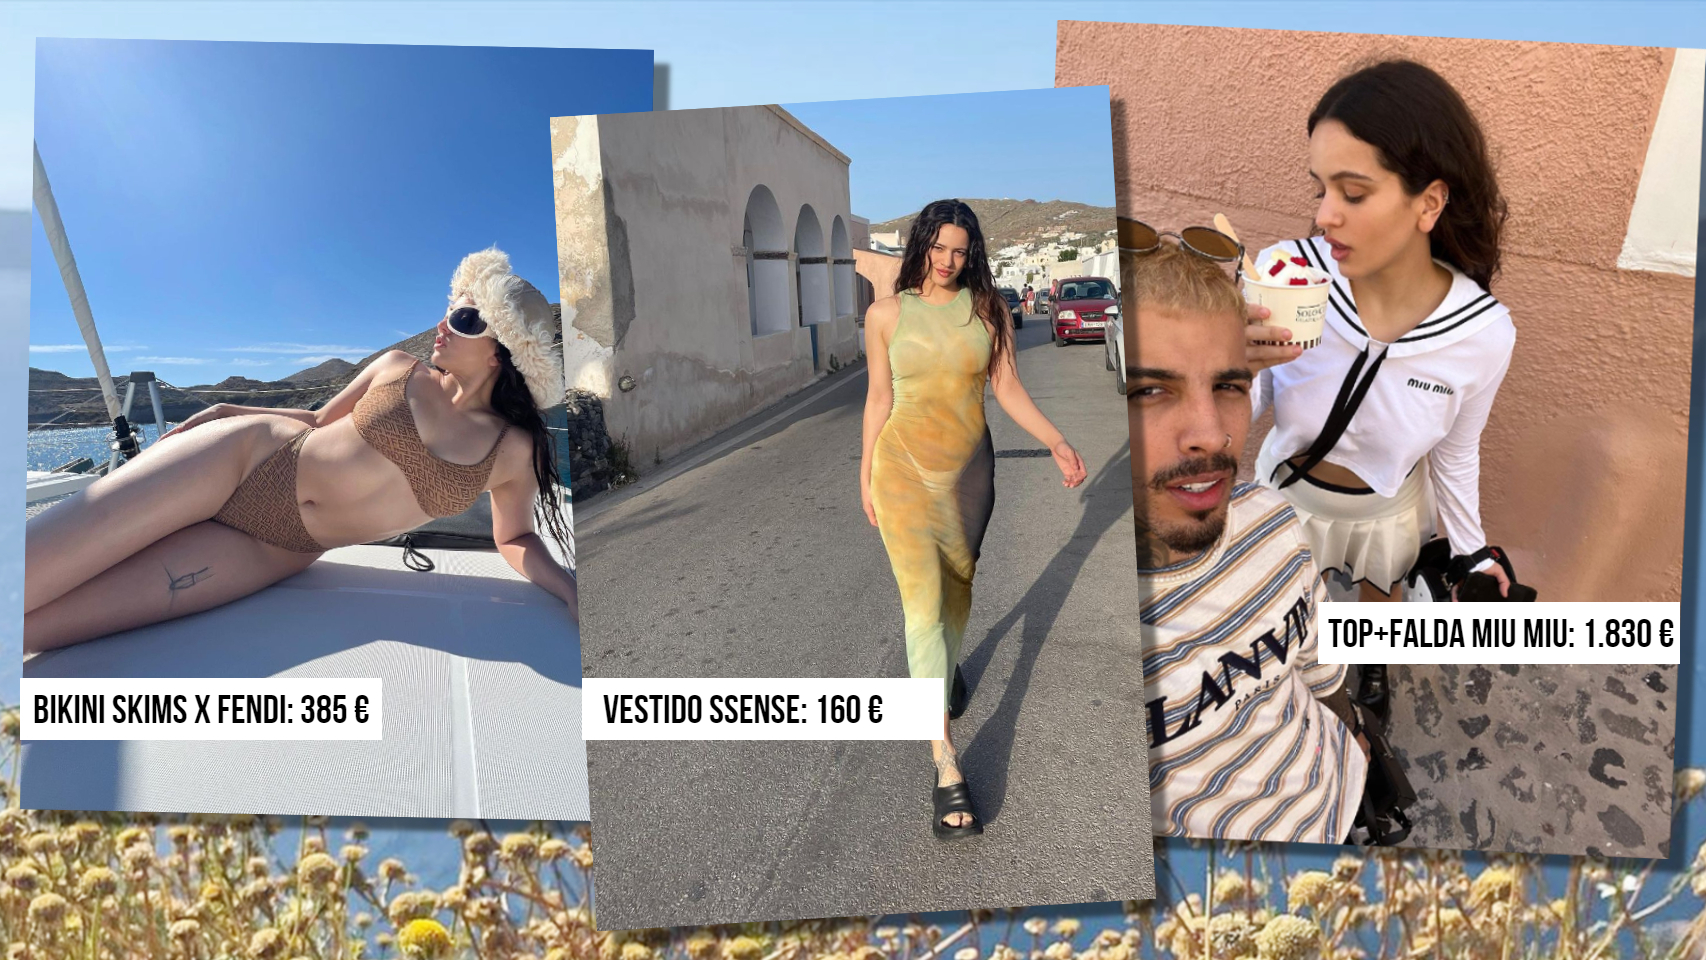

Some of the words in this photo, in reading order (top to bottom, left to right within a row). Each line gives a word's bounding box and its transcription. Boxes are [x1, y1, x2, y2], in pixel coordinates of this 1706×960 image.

[391, 437, 422, 452] FENDI
[427, 473, 459, 498] FENDI
[1235, 675, 1280, 711] PARIS
